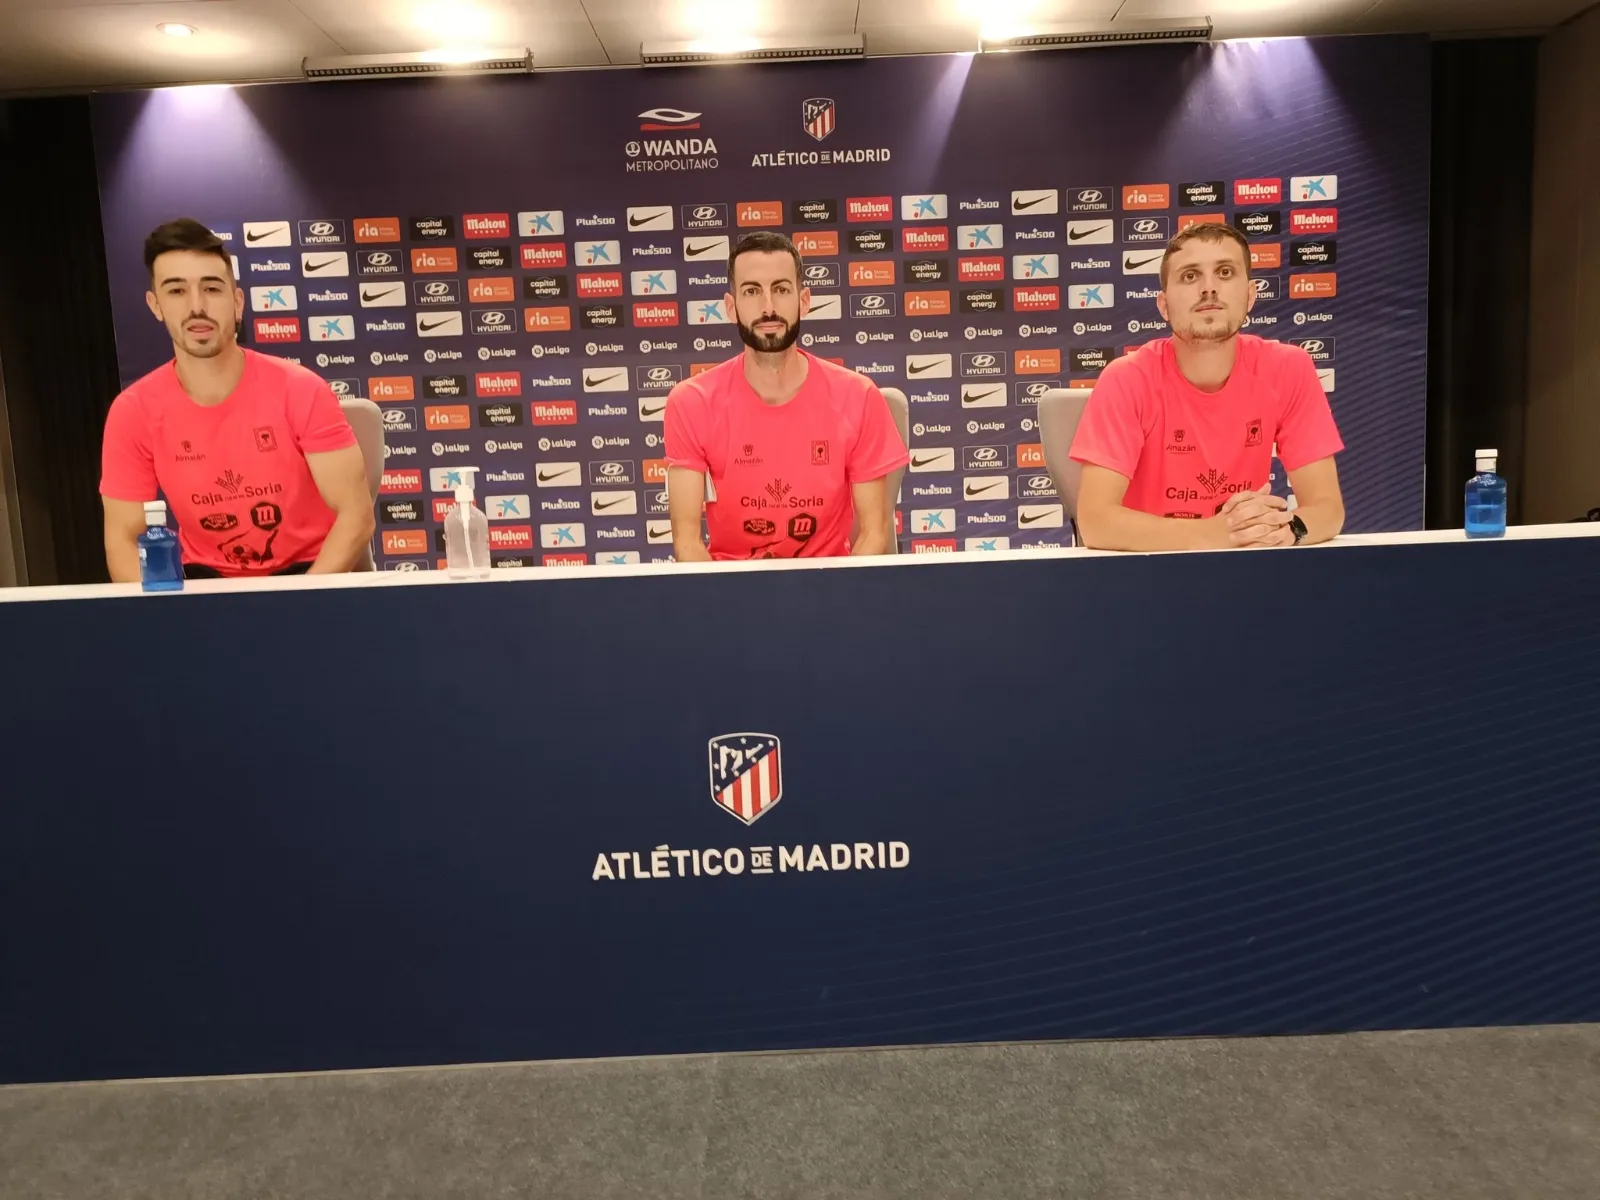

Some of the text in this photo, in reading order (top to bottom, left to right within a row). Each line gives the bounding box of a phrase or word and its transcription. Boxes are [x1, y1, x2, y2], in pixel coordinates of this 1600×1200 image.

[644, 138, 718, 156] WANDA
[752, 148, 891, 167] ATLÉTICO DE MADRID
[626, 158, 718, 172] METROPOLITANO
[1186, 185, 1212, 195] capital
[1238, 184, 1278, 195] Mahou
[1127, 190, 1147, 204] ria
[1191, 193, 1217, 203] energy
[799, 203, 825, 212] capital
[850, 202, 889, 213] Mahou
[960, 198, 999, 210] Plus500
[1073, 203, 1107, 211] HYUNDAI
[741, 207, 761, 221] ria
[804, 210, 829, 219] energy
[1242, 214, 1268, 224] capital
[416, 219, 442, 229] capital
[467, 218, 505, 230] Mahou
[576, 215, 615, 226] Plus500
[688, 219, 722, 227] HYUNDAI
[1293, 214, 1334, 225] Mahou
[359, 223, 379, 237] ria
[422, 227, 447, 236] energy
[1247, 222, 1272, 231] energy
[855, 233, 881, 242] capital
[905, 232, 945, 243] Mahou
[1016, 228, 1055, 239] Plus500
[1128, 232, 1163, 240] HYUNDAI
[305, 235, 340, 243] HYUNDAI
[798, 236, 816, 250] ria
[633, 244, 672, 255] Plus500
[860, 240, 885, 249] energy
[1298, 245, 1324, 254] capital
[474, 249, 499, 259] capital
[523, 248, 562, 259] Mahou
[1302, 253, 1328, 261] energy
[416, 253, 435, 267] ria
[478, 257, 504, 266] energy
[1071, 258, 1110, 269] Plus500
[251, 260, 291, 272] Plus500
[911, 263, 937, 272] capital
[961, 261, 1001, 272] Mahou
[854, 266, 873, 280] ria
[916, 270, 941, 279] energy
[530, 279, 556, 288] capital
[580, 278, 619, 289] Mahou
[688, 274, 728, 285] Plus500
[473, 282, 493, 297] ria
[535, 286, 560, 295] energy
[1294, 279, 1314, 292] ria
[309, 290, 348, 301] Plus500
[421, 295, 455, 303] HYUNDAI
[967, 292, 992, 302] capital
[1017, 291, 1056, 302] Mahou
[909, 296, 929, 310] ria
[972, 300, 997, 309] energy
[587, 308, 612, 317] capital
[636, 307, 675, 318] Mahou
[856, 308, 890, 316] HYUNDAI
[1307, 312, 1333, 322] LaLiga
[530, 312, 549, 326] ria
[592, 315, 616, 324] energy
[1251, 315, 1277, 325] LaLiga
[257, 322, 297, 334] Mahou
[366, 320, 405, 331] Plus500
[477, 324, 511, 332] HYUNDAI
[1032, 325, 1057, 335] LaLiga
[1086, 323, 1112, 332] LaLiga
[1141, 320, 1166, 330] LaLiga
[869, 332, 894, 341] LaLiga
[923, 330, 948, 339] LaLiga
[978, 328, 1002, 337] LaLiga
[706, 338, 732, 348] LaLiga
[814, 334, 840, 343] LaLiga
[545, 345, 570, 355] LaLiga
[599, 343, 624, 352] LaLiga
[653, 341, 678, 350] LaLiga
[383, 352, 409, 362] LaLiga
[437, 350, 462, 360] LaLiga
[491, 348, 516, 357] LaLiga
[1077, 351, 1103, 360] capital
[329, 354, 355, 364] LaLiga
[1019, 354, 1039, 368] ria
[1082, 358, 1107, 367] energy
[855, 362, 894, 374] Plus500
[967, 367, 1001, 375] HYUNDAI
[430, 378, 455, 388] capital
[479, 376, 517, 387] Mahou
[533, 375, 571, 387] Plus500
[643, 380, 677, 388] HYUNDAI
[373, 382, 392, 396] ria
[435, 385, 460, 395] energy
[911, 391, 949, 402] Plus500
[486, 406, 511, 415] capital
[535, 406, 573, 416] Mahou
[588, 404, 627, 415] Plus500
[430, 410, 448, 424] ria
[490, 414, 515, 423] energy
[926, 424, 951, 433] LaLiga
[980, 422, 1005, 431] LaLiga
[498, 441, 522, 450] LaLiga
[552, 438, 576, 447] LaLiga
[605, 436, 630, 446] LaLiga
[392, 446, 416, 454] LaLiga
[445, 444, 470, 452] LaLiga
[1022, 447, 1041, 461] ria
[381, 473, 418, 485] Mahou
[486, 470, 525, 482] Plus500
[191, 492, 223, 506] Caja
[245, 483, 282, 498] Soria
[913, 484, 952, 495] Plus500
[1166, 487, 1198, 502] Caja
[387, 503, 412, 512] capital
[542, 499, 580, 510] Plus500
[741, 496, 824, 510] Caja Soria
[392, 511, 417, 520] energy
[967, 512, 1006, 523] Plus500
[491, 530, 528, 541] Mahou
[597, 527, 635, 538] Plus500
[387, 536, 406, 548] ria
[592, 841, 910, 880] ATLÉTICO DE MADRID
